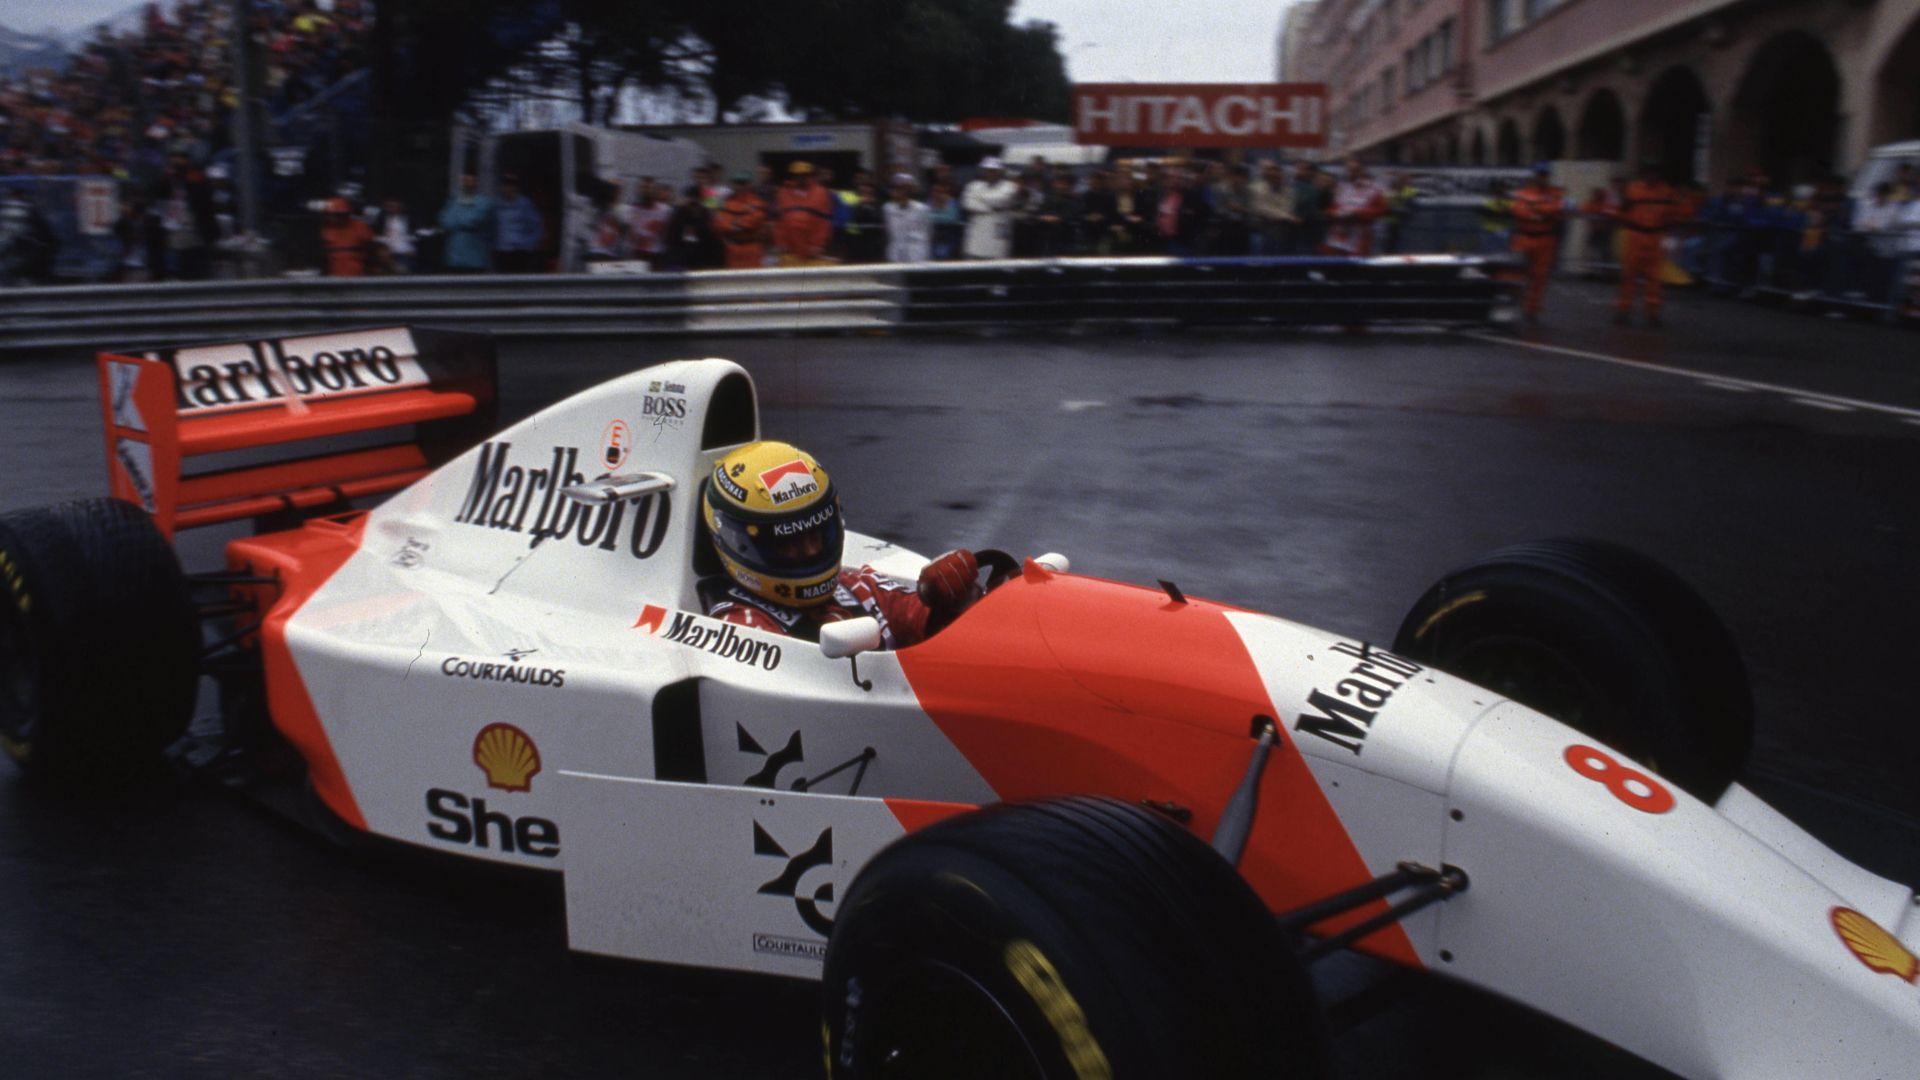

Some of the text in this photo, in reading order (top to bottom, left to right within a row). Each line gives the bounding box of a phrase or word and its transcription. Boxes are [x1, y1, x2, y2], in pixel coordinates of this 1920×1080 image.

[1079, 96, 1321, 135] HITACHI
[643, 395, 687, 419] BOSS
[455, 442, 671, 559] Marlboro
[717, 466, 744, 499] NACIONAL
[772, 482, 818, 504] Marlboro
[774, 504, 834, 536] KENWOOD
[661, 612, 781, 671] Marlboro
[441, 657, 566, 687] COURTAULDS
[1294, 641, 1424, 756] Marlb
[1563, 744, 1677, 815] 8
[426, 788, 561, 858] She
[757, 935, 828, 956] COURTAULD
